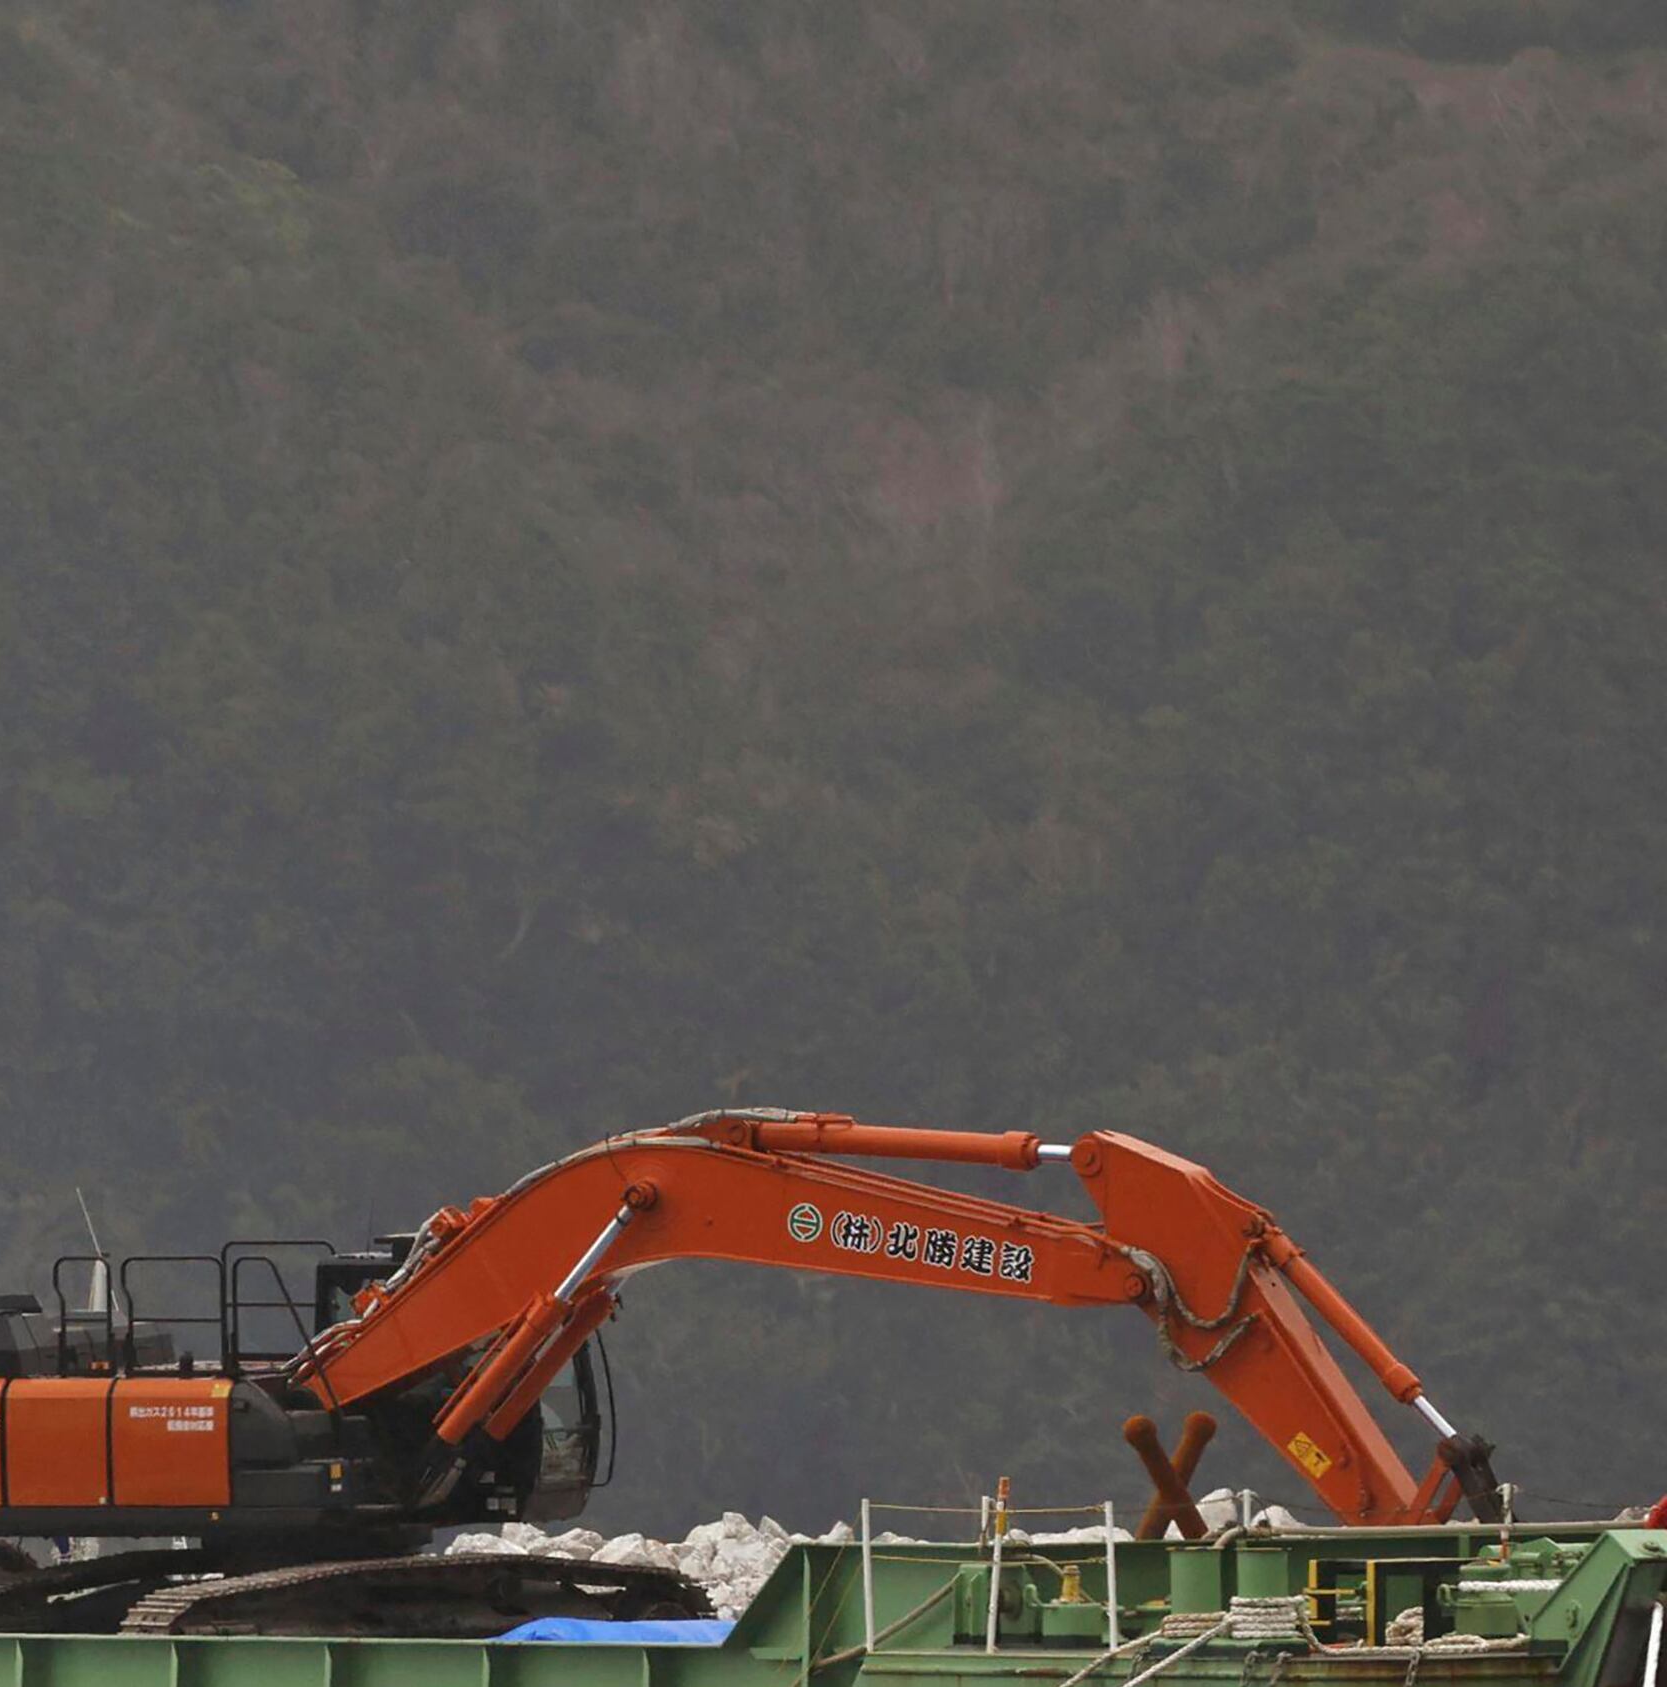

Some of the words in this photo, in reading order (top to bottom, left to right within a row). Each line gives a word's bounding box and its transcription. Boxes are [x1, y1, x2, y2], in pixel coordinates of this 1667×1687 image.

[832, 1211, 1033, 1282] (株)北勝建設
